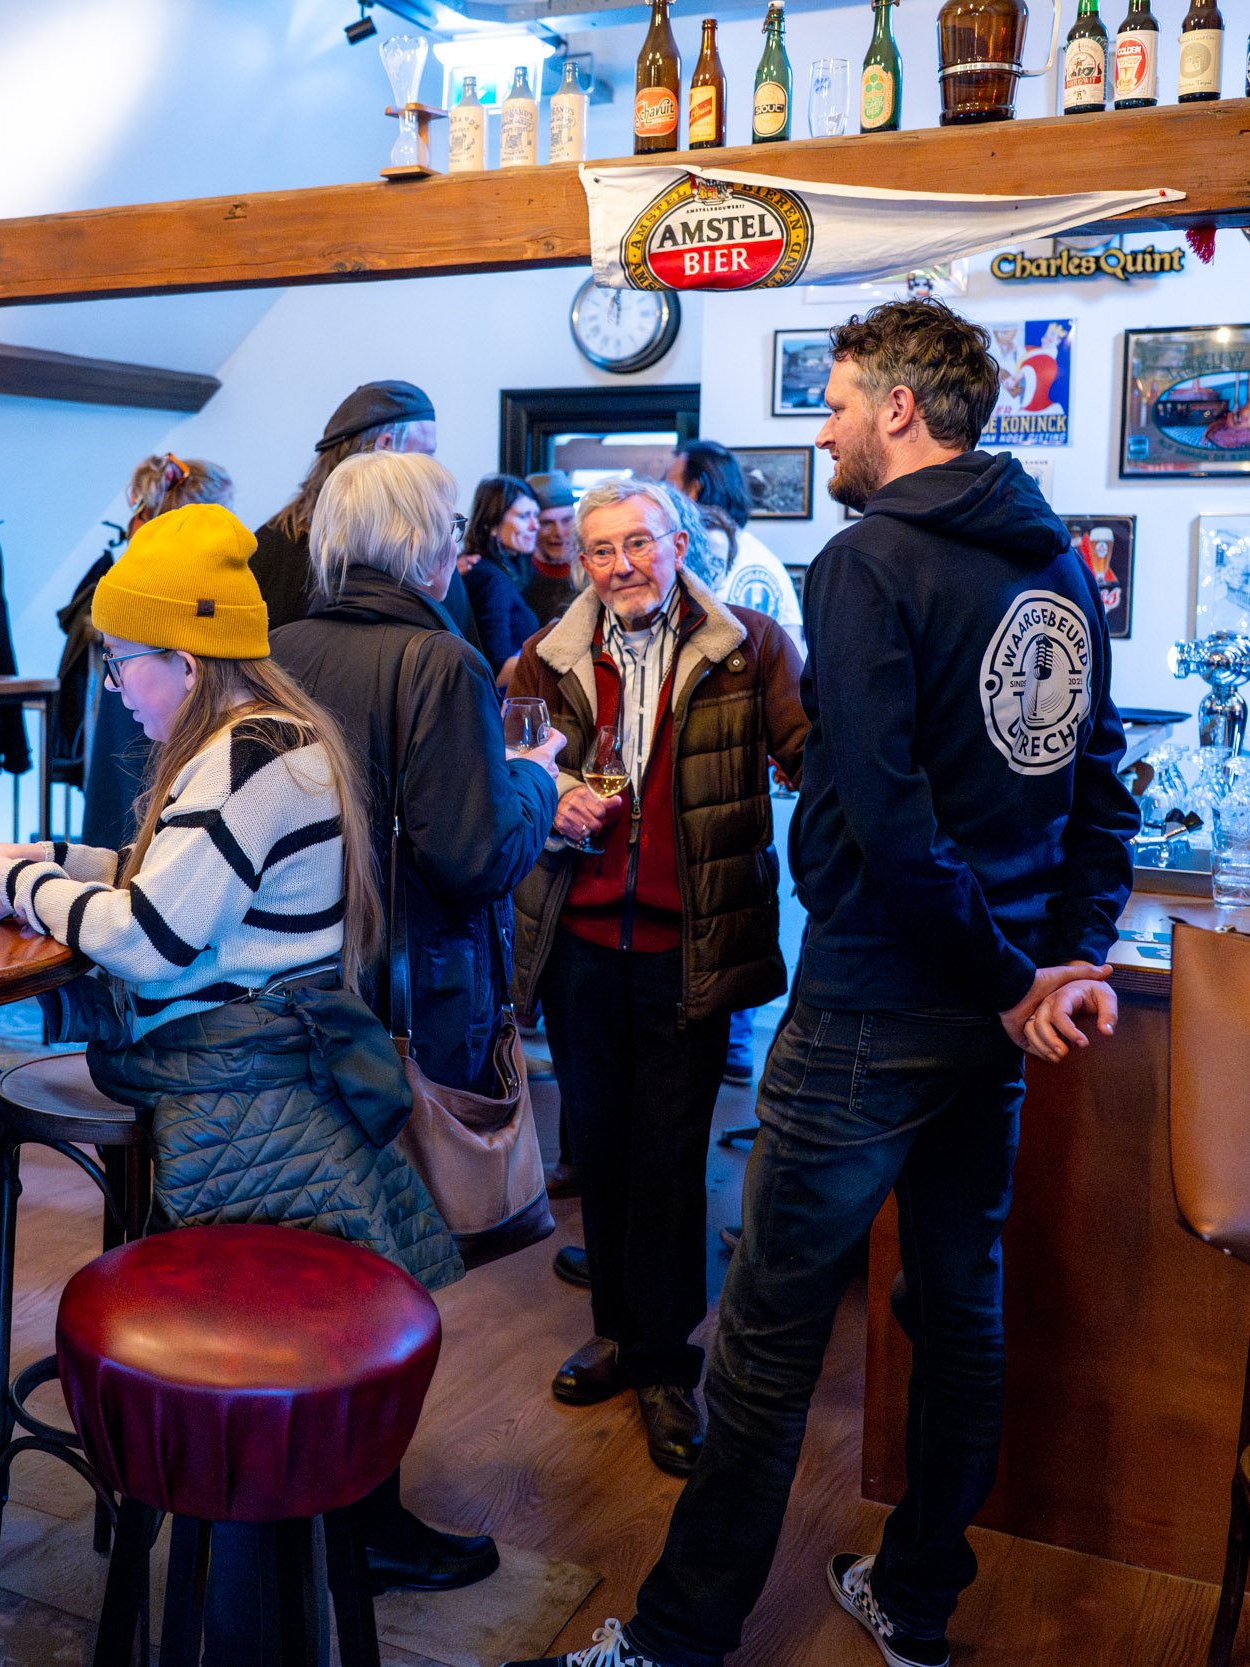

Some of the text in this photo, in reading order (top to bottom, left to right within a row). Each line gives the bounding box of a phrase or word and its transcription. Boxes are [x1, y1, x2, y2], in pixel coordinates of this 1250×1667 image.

[630, 187, 688, 251] AMSTEL
[740, 183, 803, 230] BIEREN
[656, 213, 774, 249] AMSTEL
[683, 247, 751, 276] BIER
[991, 244, 1186, 281] Charles Quint
[1000, 415, 1067, 433] KONINCK
[1001, 608, 1088, 668] WAARGEBEURD
[1009, 679, 1027, 688] SINDS
[1007, 712, 1081, 757] UTRECHT
